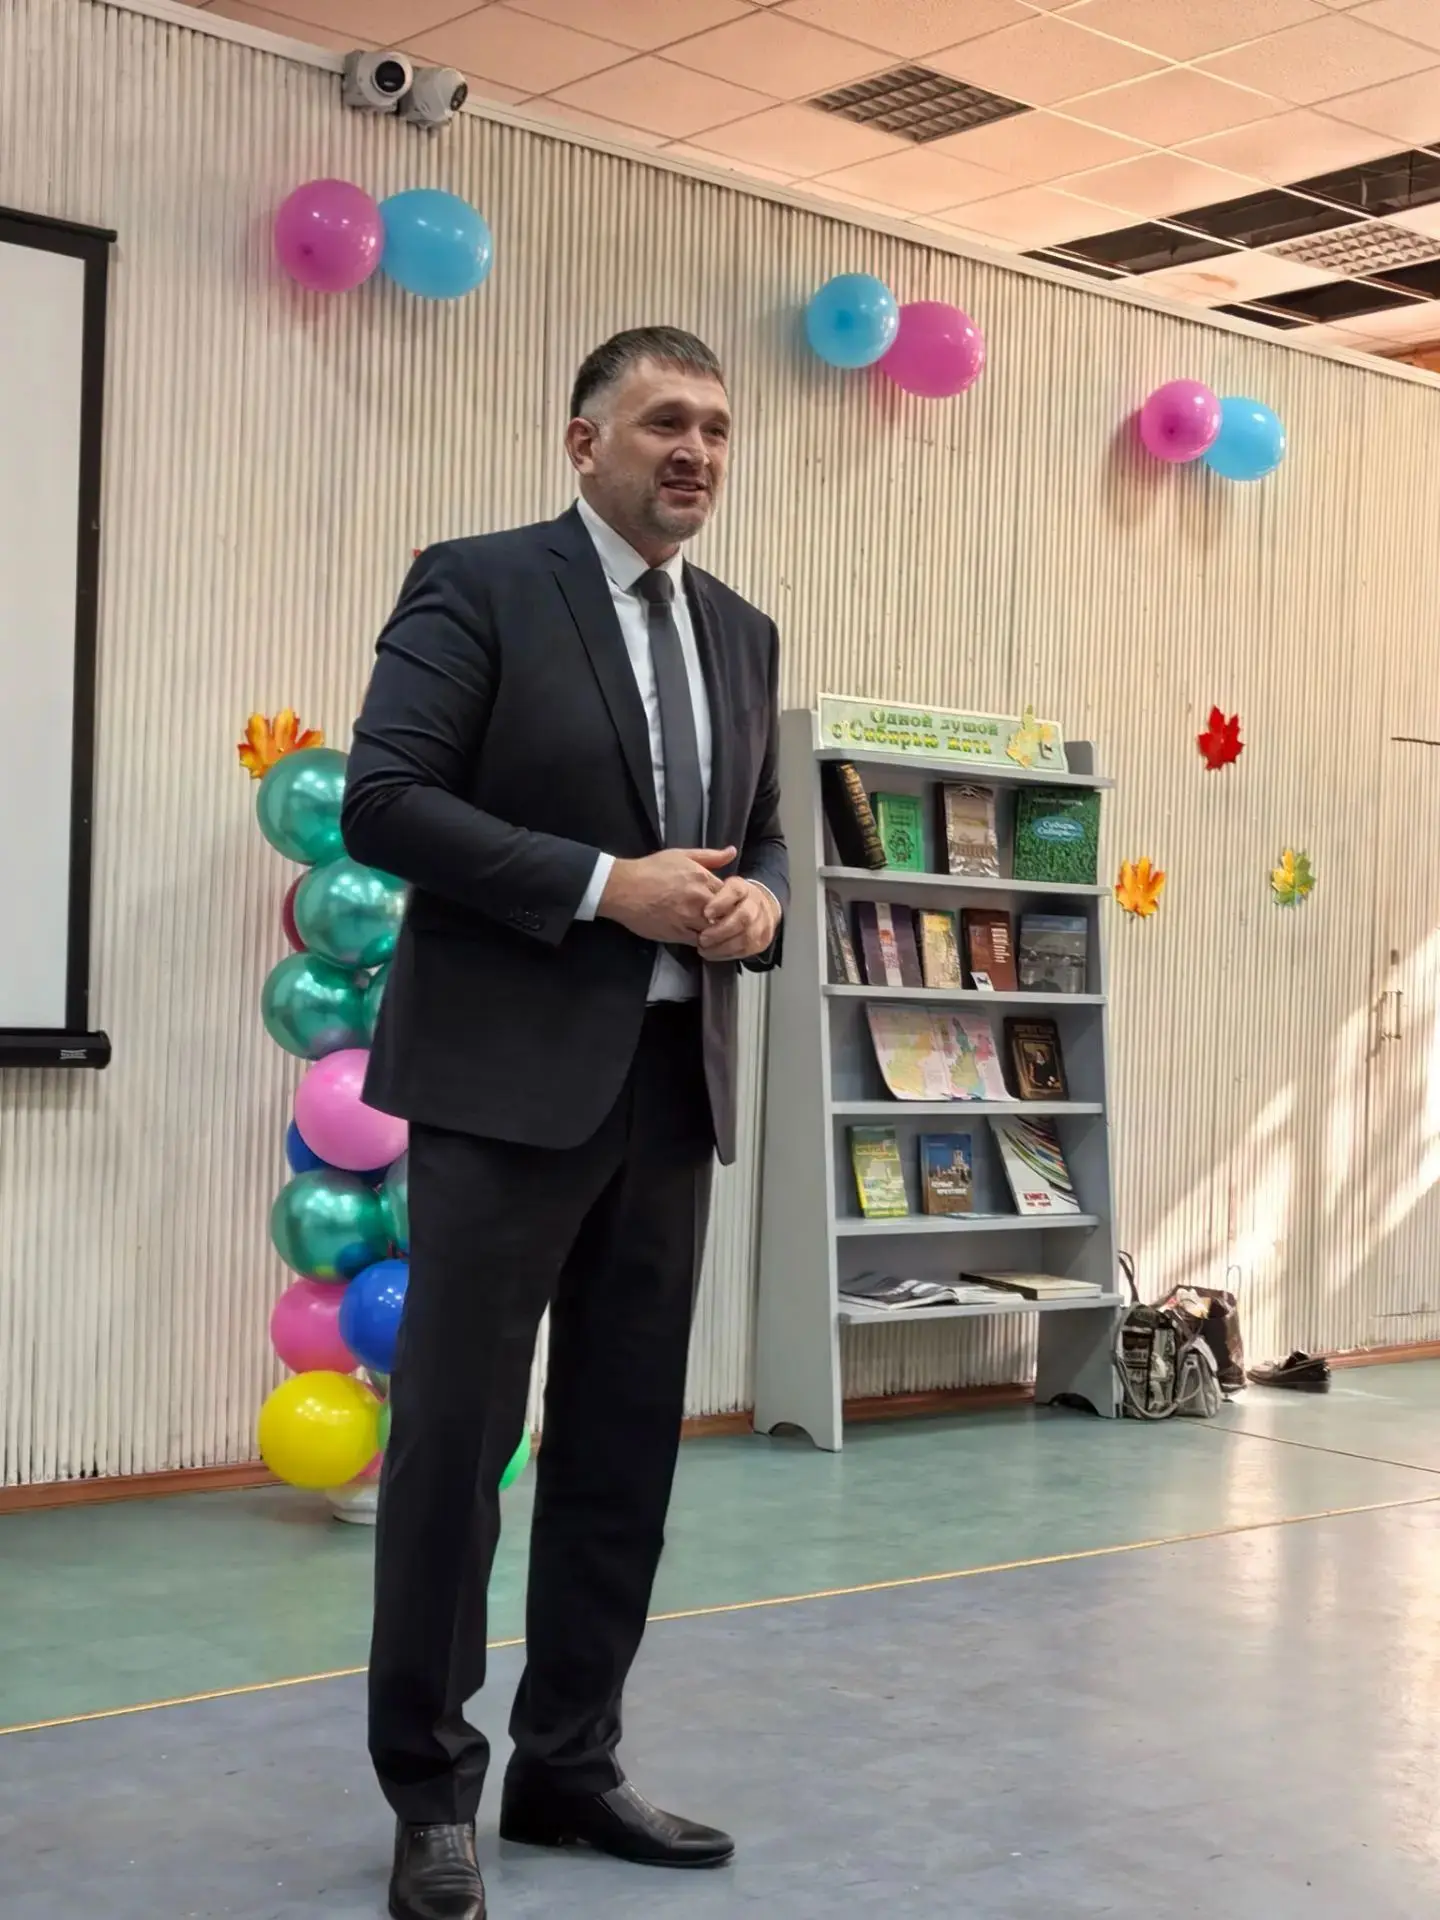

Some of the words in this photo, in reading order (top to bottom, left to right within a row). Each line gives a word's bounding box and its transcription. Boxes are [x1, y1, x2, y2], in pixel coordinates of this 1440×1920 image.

[849, 718, 940, 750] Сибирью
[947, 735, 993, 755] жить
[870, 708, 933, 729] Одной
[940, 719, 999, 737] душой
